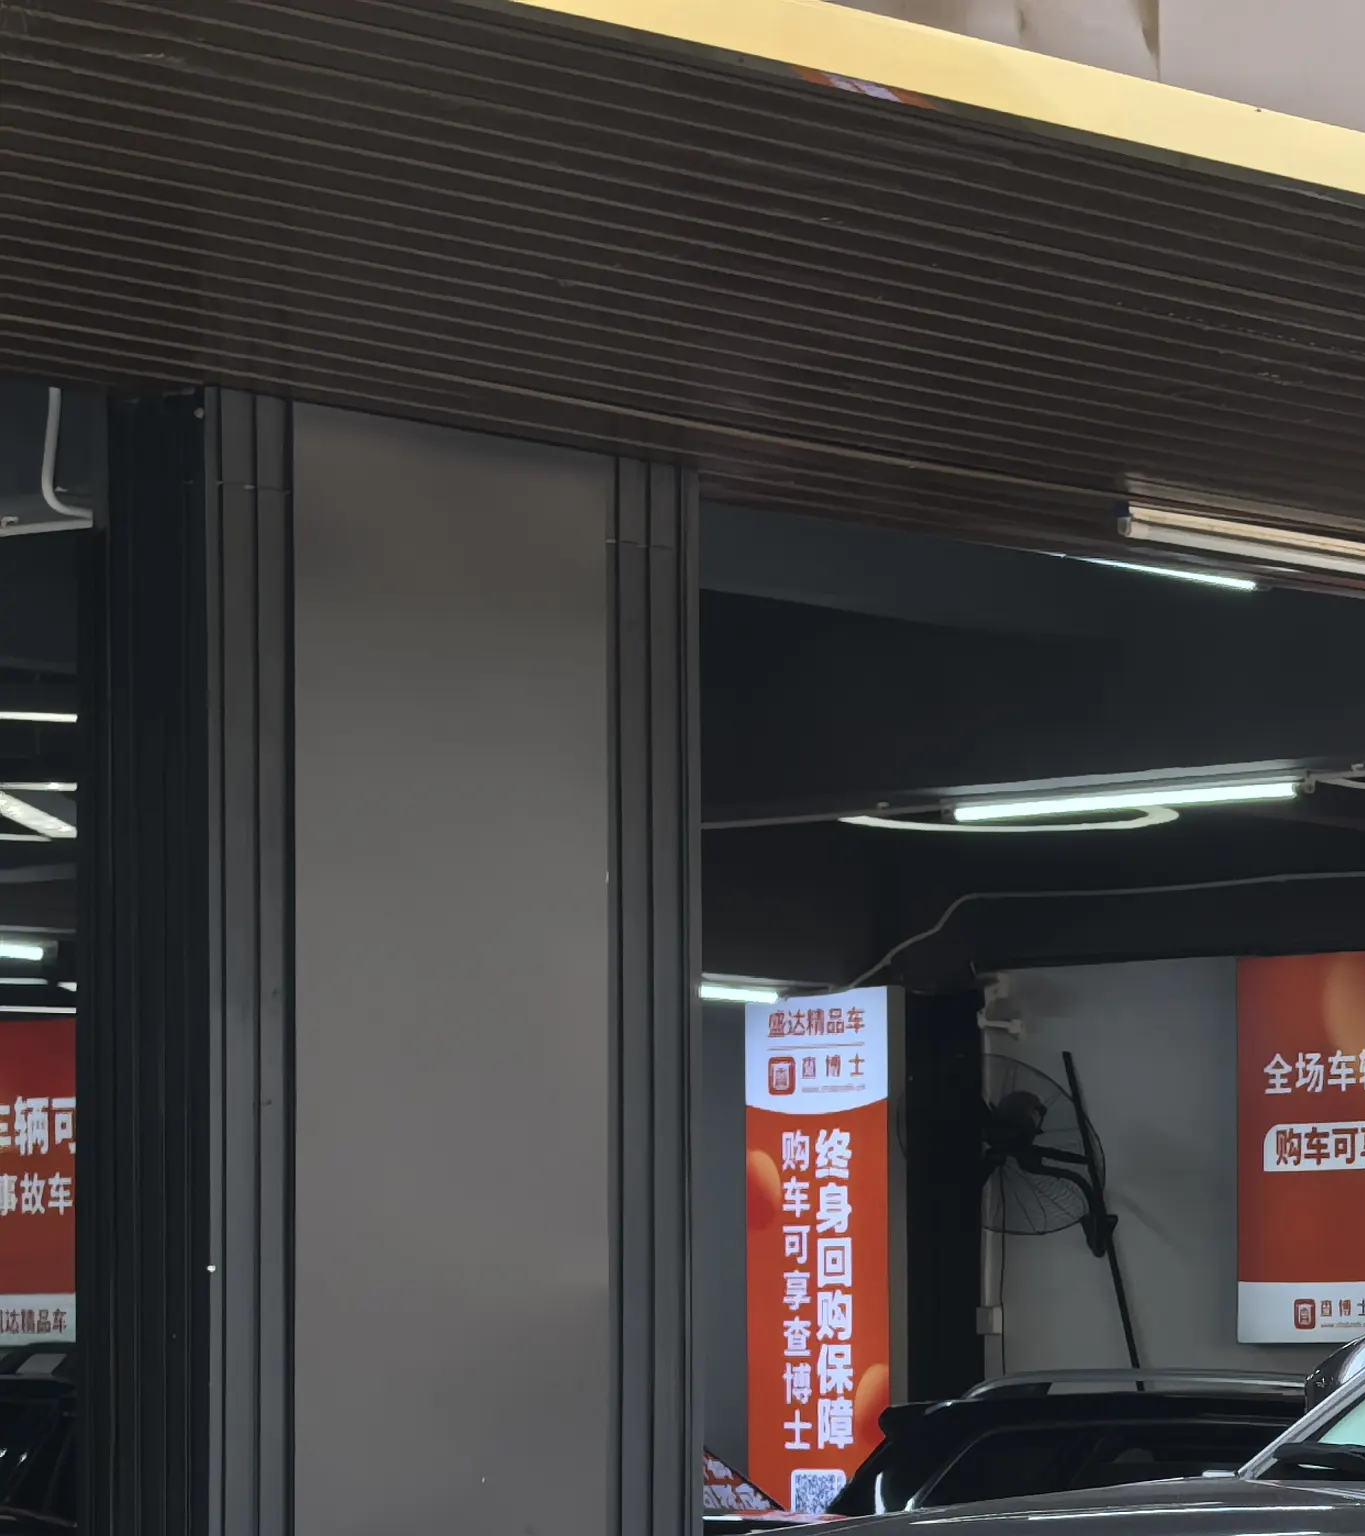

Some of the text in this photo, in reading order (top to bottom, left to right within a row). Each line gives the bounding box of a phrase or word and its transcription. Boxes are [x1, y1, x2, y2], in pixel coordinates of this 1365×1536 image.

[768, 1007, 865, 1037] 盛达精品车
[782, 1129, 812, 1450] 购车可享查博士
[815, 1128, 854, 1450] 终身回购保障
